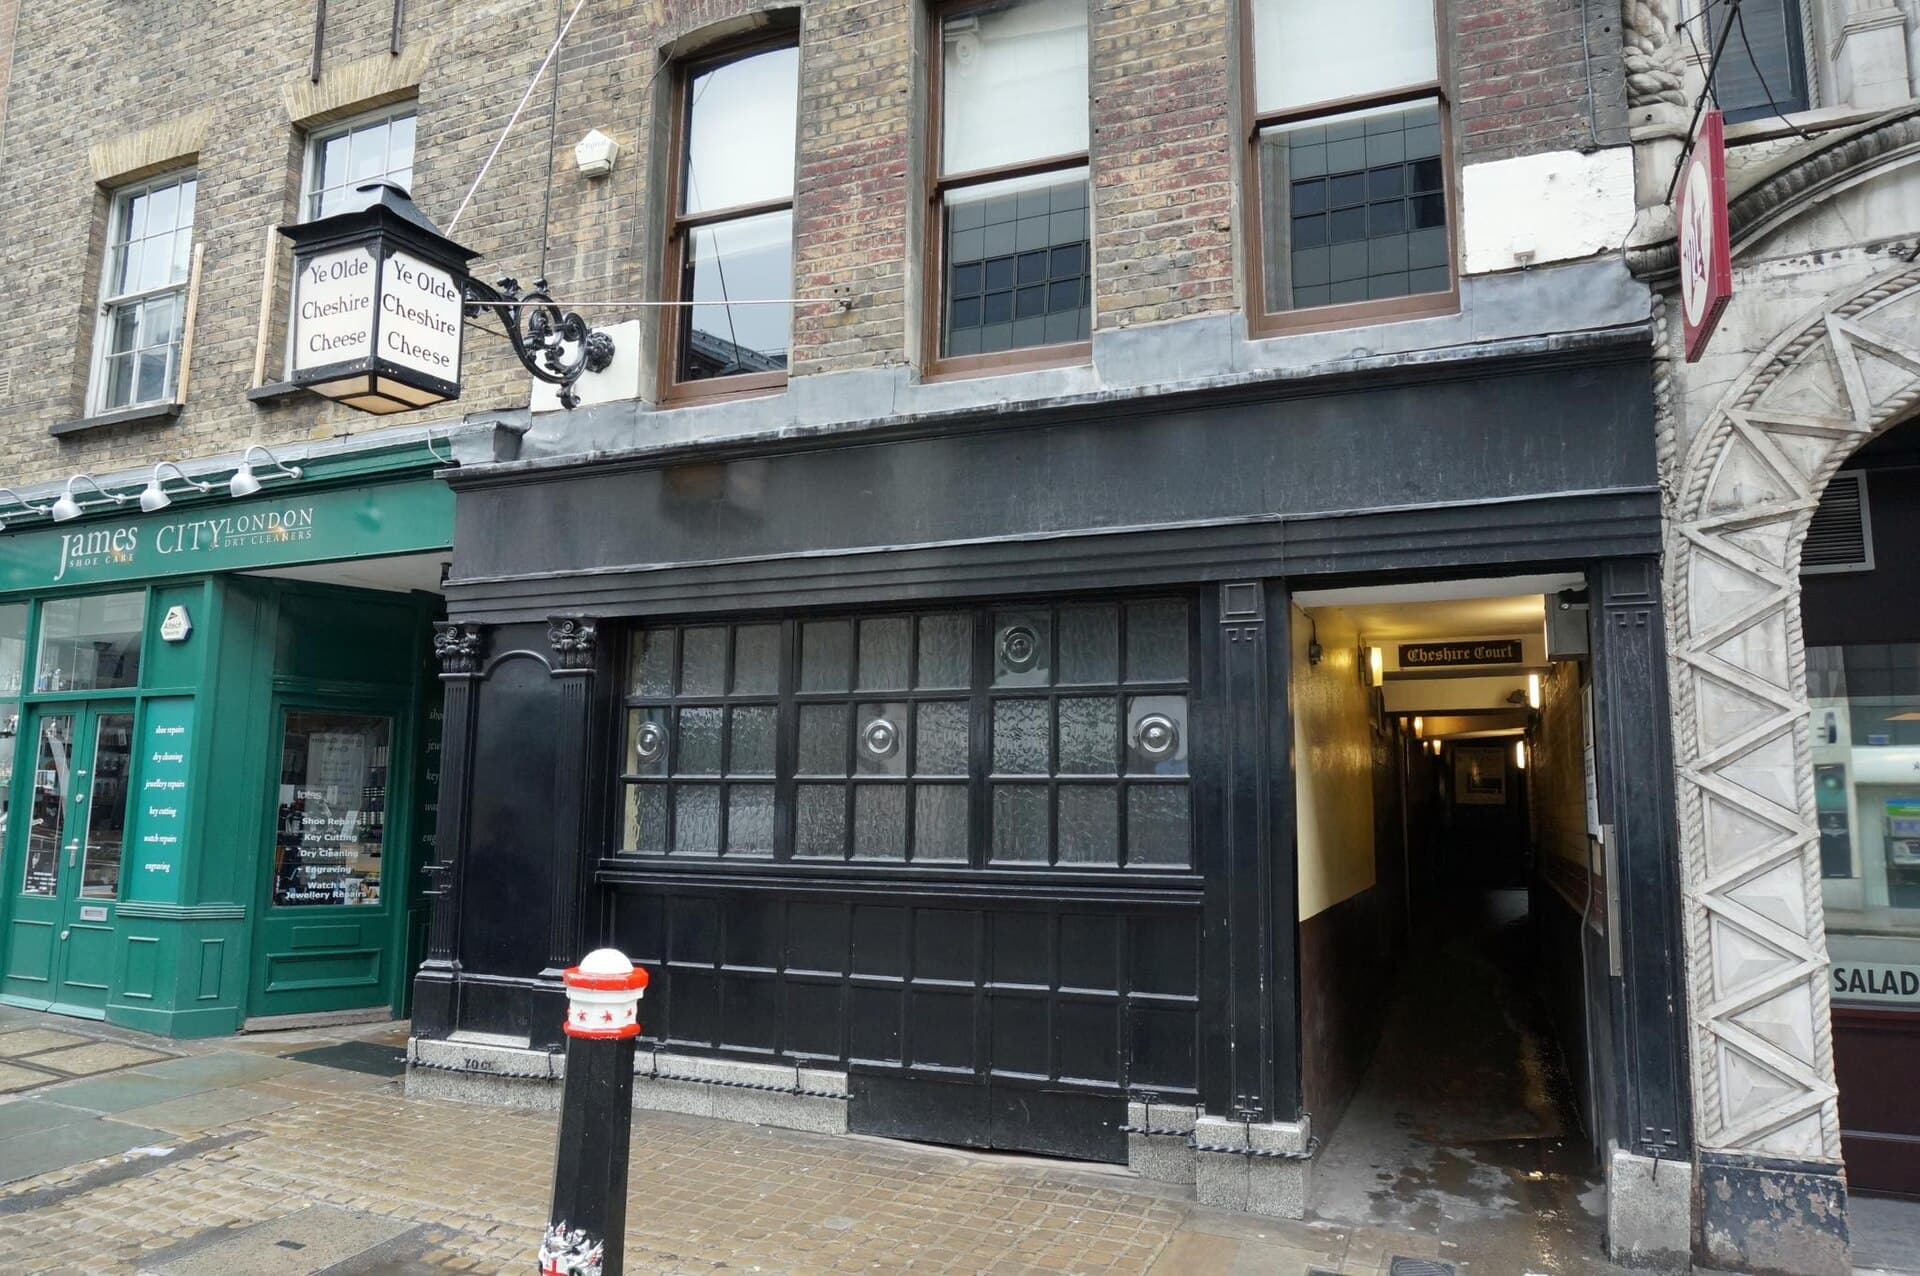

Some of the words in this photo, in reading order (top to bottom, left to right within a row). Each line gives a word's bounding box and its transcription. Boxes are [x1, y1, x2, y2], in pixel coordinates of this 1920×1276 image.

[311, 265, 328, 284] Ye
[330, 258, 368, 280] Olde
[394, 260, 412, 284] Ye
[417, 272, 456, 302] Olde
[302, 294, 369, 319] Cheshire
[383, 293, 456, 336] Cheshire
[309, 331, 366, 352] Cheese
[388, 331, 450, 367] Cheese
[156, 518, 229, 554] CITY
[225, 508, 313, 534] LONDON
[224, 537, 246, 548] DRY
[251, 529, 313, 545] CLEANERS
[53, 526, 138, 580] James
[105, 553, 135, 565] CARE
[1407, 647, 1469, 663] Cheshire
[1474, 645, 1513, 660] Court
[302, 817, 325, 825] Shoe
[327, 817, 361, 828] Repairs
[304, 834, 322, 842] Key
[324, 833, 358, 843] Cutting
[300, 850, 317, 859] Dry
[319, 849, 359, 859] Cleaning
[305, 865, 352, 875] Engraving
[284, 890, 330, 900] Jewellery
[332, 890, 367, 899] Repairs
[307, 882, 337, 890] Watch
[1833, 967, 1920, 996] SALAD
